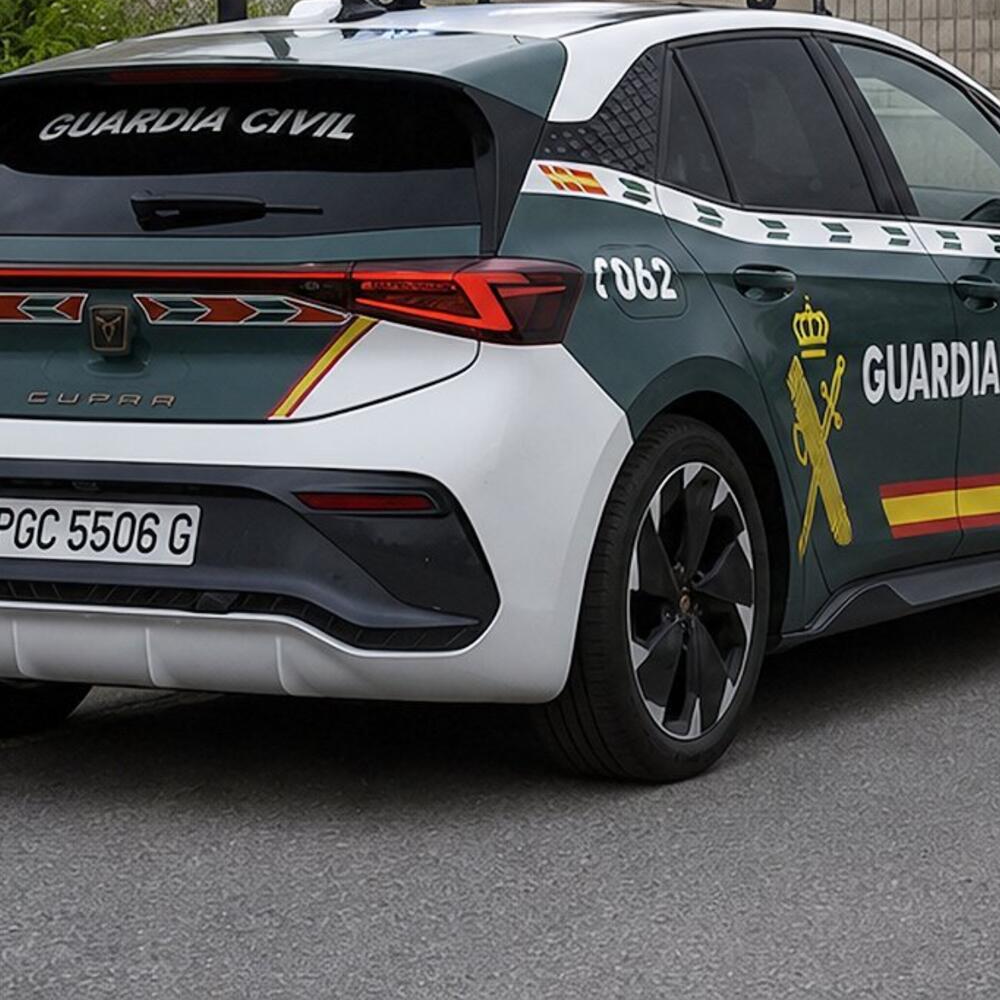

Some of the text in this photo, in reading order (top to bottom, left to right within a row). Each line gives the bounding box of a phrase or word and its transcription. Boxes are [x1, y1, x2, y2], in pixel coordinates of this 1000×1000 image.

[38, 106, 356, 141] GUARDIA CIVIL
[27, 391, 177, 408] CUPRA
[67, 509, 161, 555] 5506
[168, 513, 194, 556] G
